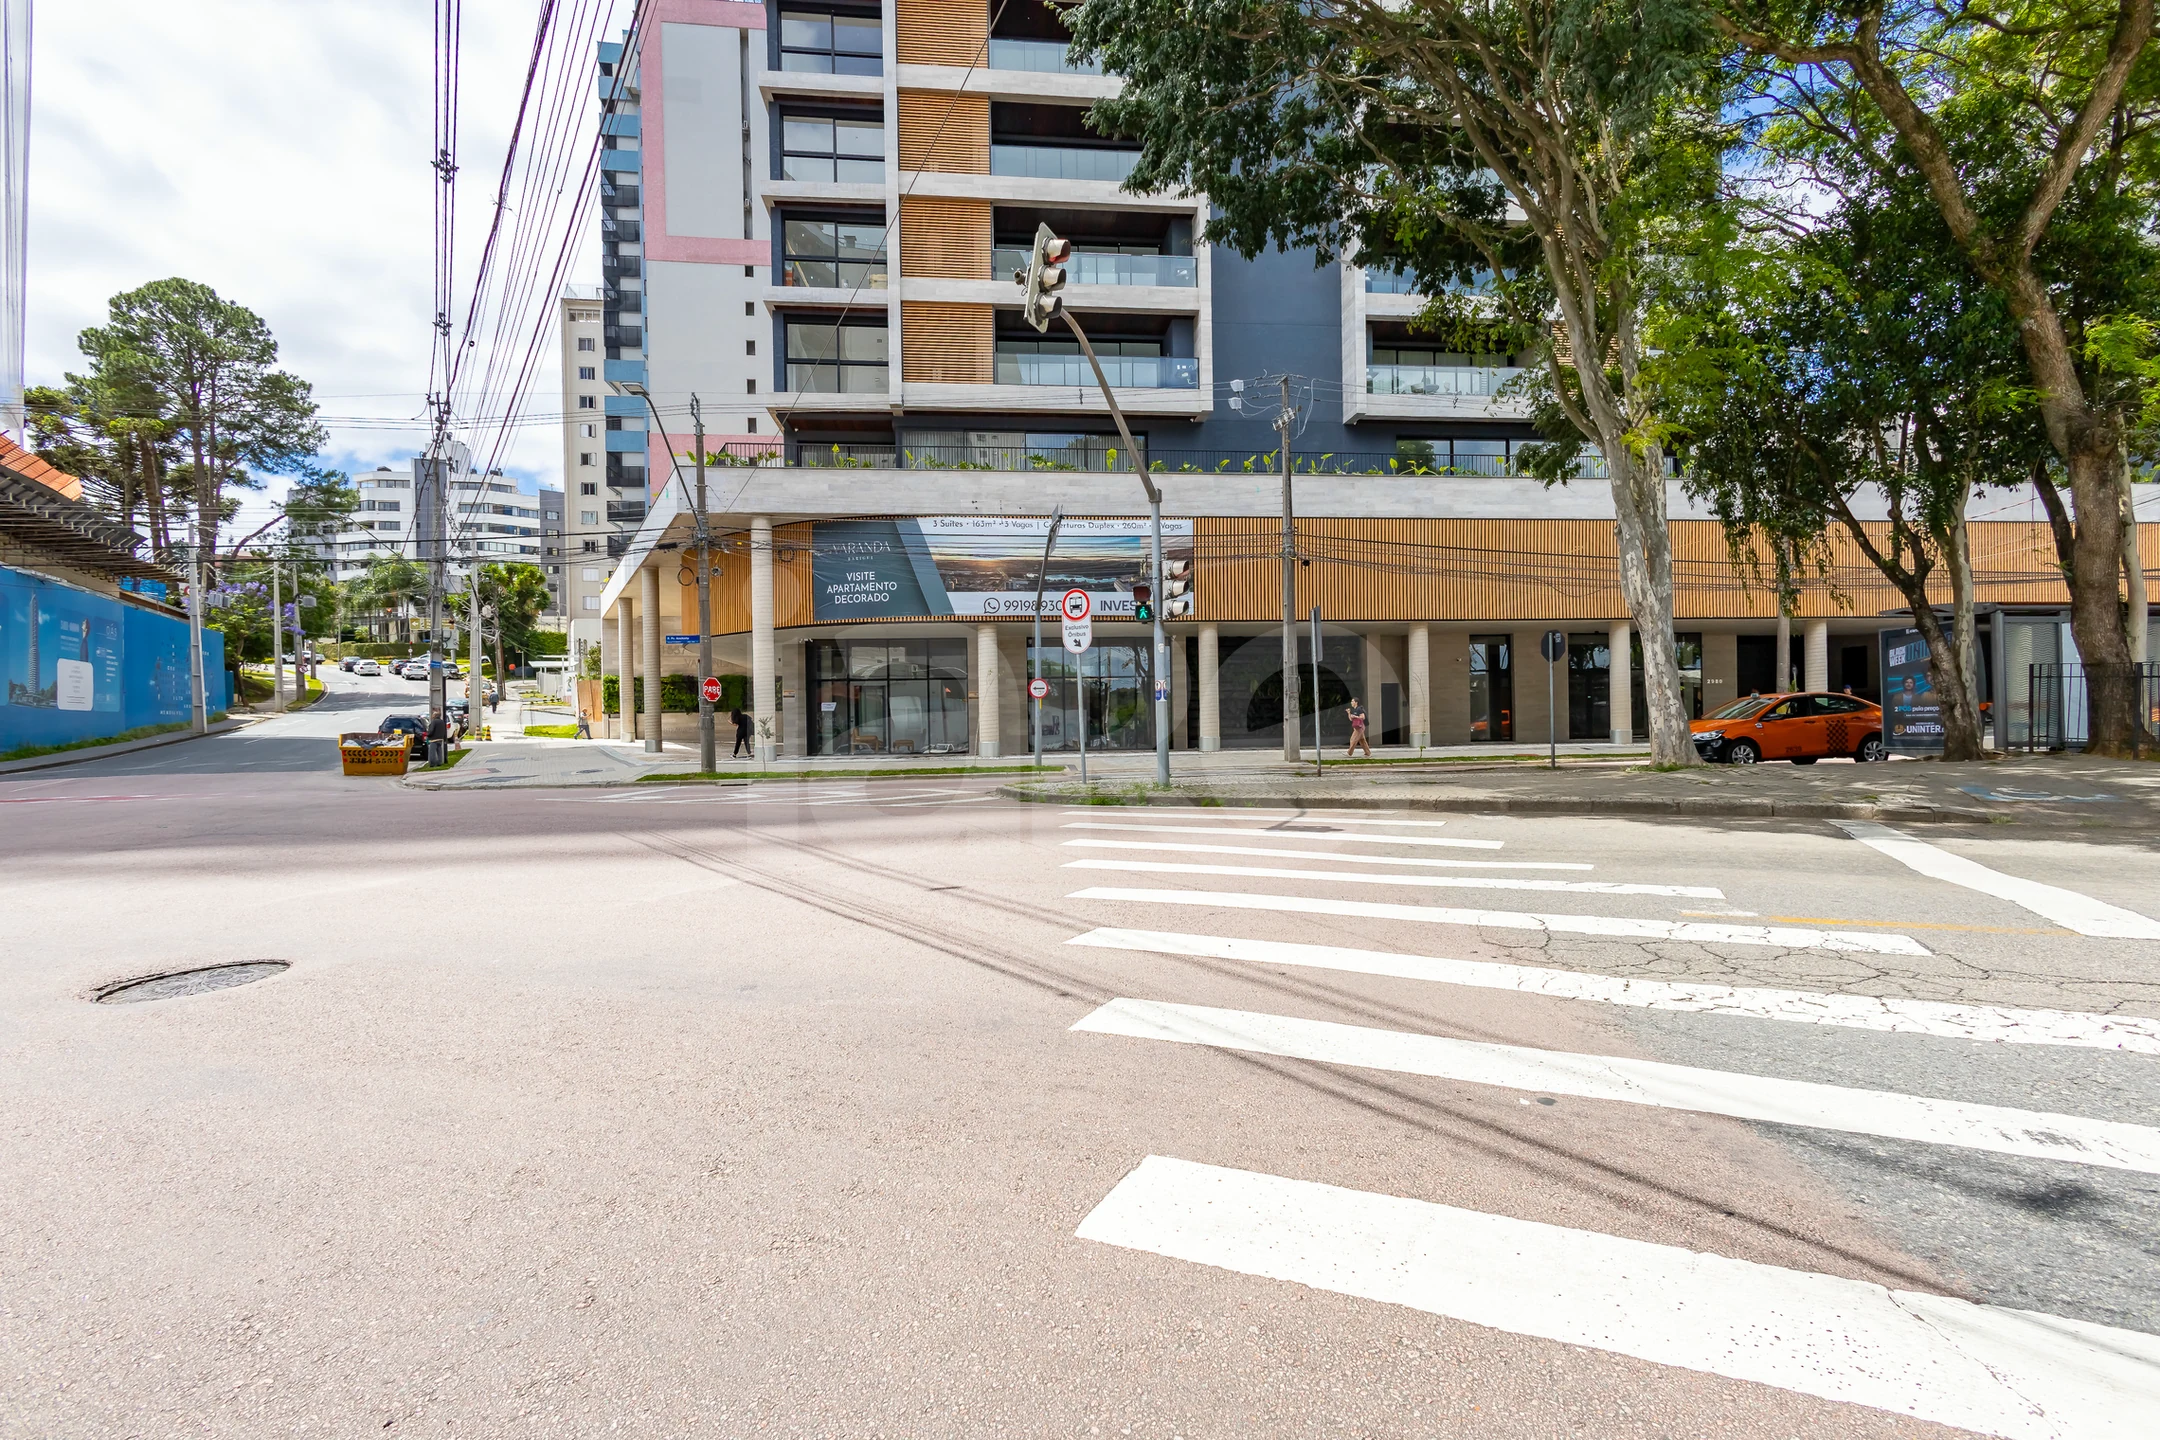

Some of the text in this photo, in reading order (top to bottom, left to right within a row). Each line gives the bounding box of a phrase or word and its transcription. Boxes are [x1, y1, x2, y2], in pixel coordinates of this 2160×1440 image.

[933, 520, 938, 528] 3
[1011, 521, 1033, 529] Vagas
[1043, 521, 1086, 529] Certuras
[832, 541, 891, 554] VARANDA
[846, 571, 876, 581] VISITE
[826, 582, 898, 594] APARTAMENTO
[834, 593, 890, 604] DECORADO
[1067, 630, 1087, 638] Ônibus
[1889, 646, 1906, 658] BLACK
[1889, 655, 1906, 667] WEEK
